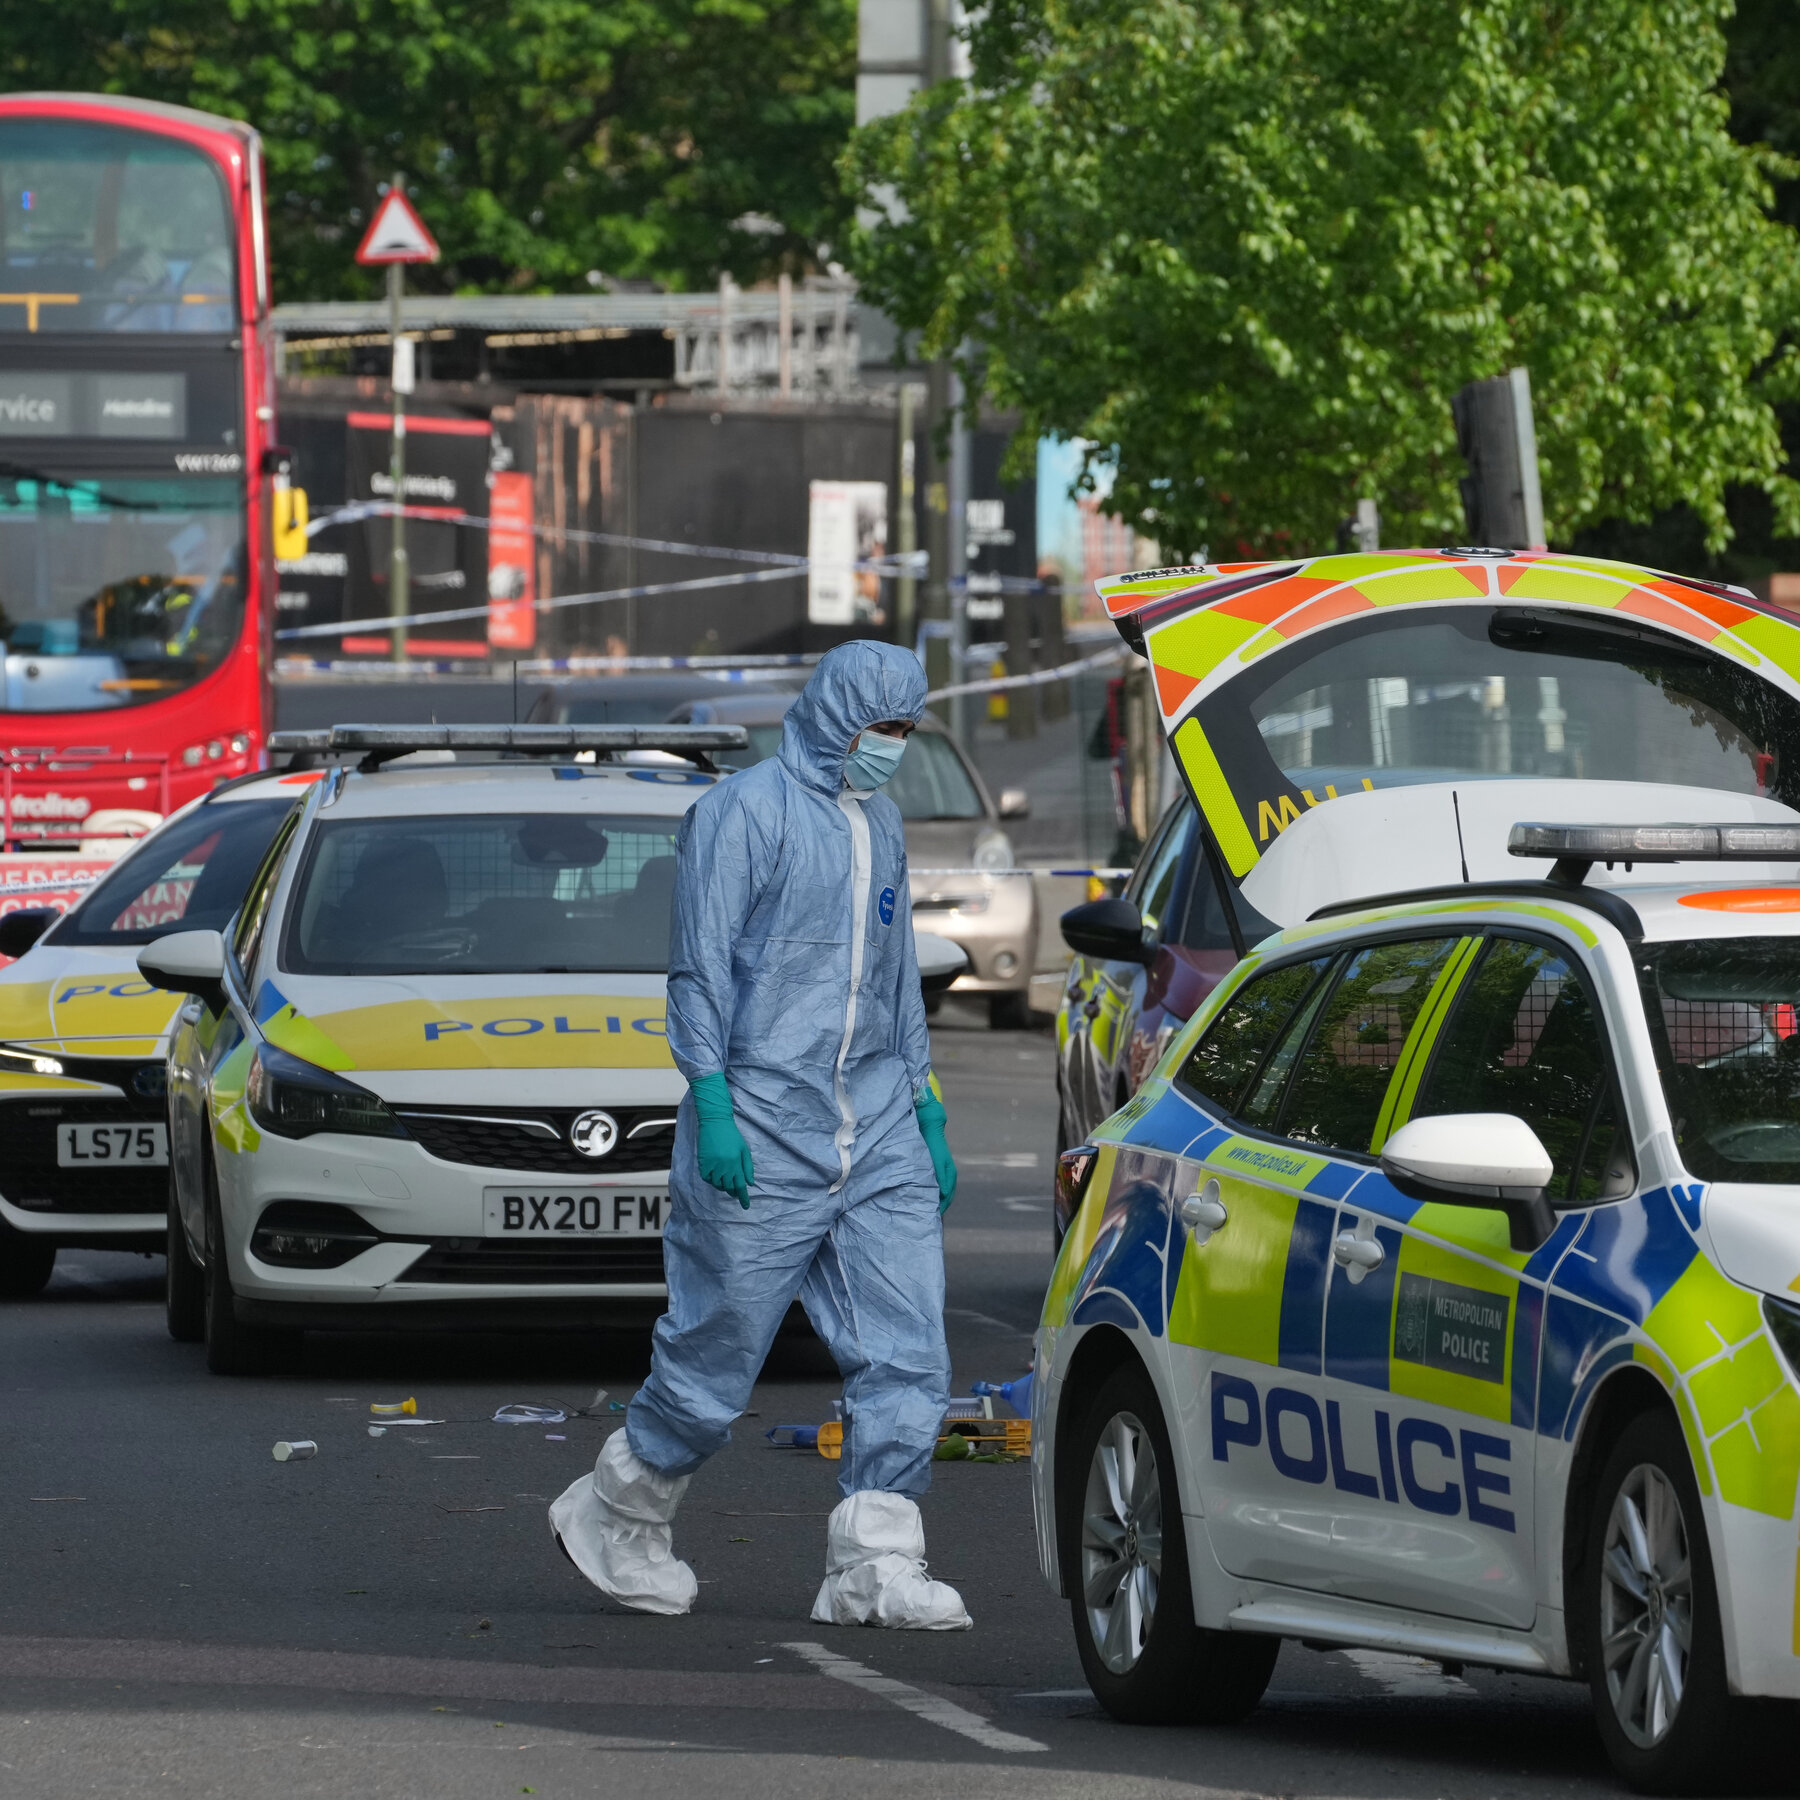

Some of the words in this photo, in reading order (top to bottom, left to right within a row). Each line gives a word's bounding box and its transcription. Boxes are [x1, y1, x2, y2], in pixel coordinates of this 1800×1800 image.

[56, 981, 187, 1004] PO
[70, 1128, 155, 1159] LS75
[502, 1196, 600, 1231] BX20
[1434, 1296, 1503, 1331] METROPOLITAN
[1441, 1331, 1490, 1365] POLICE
[1211, 1370, 1517, 1534] POLICE
